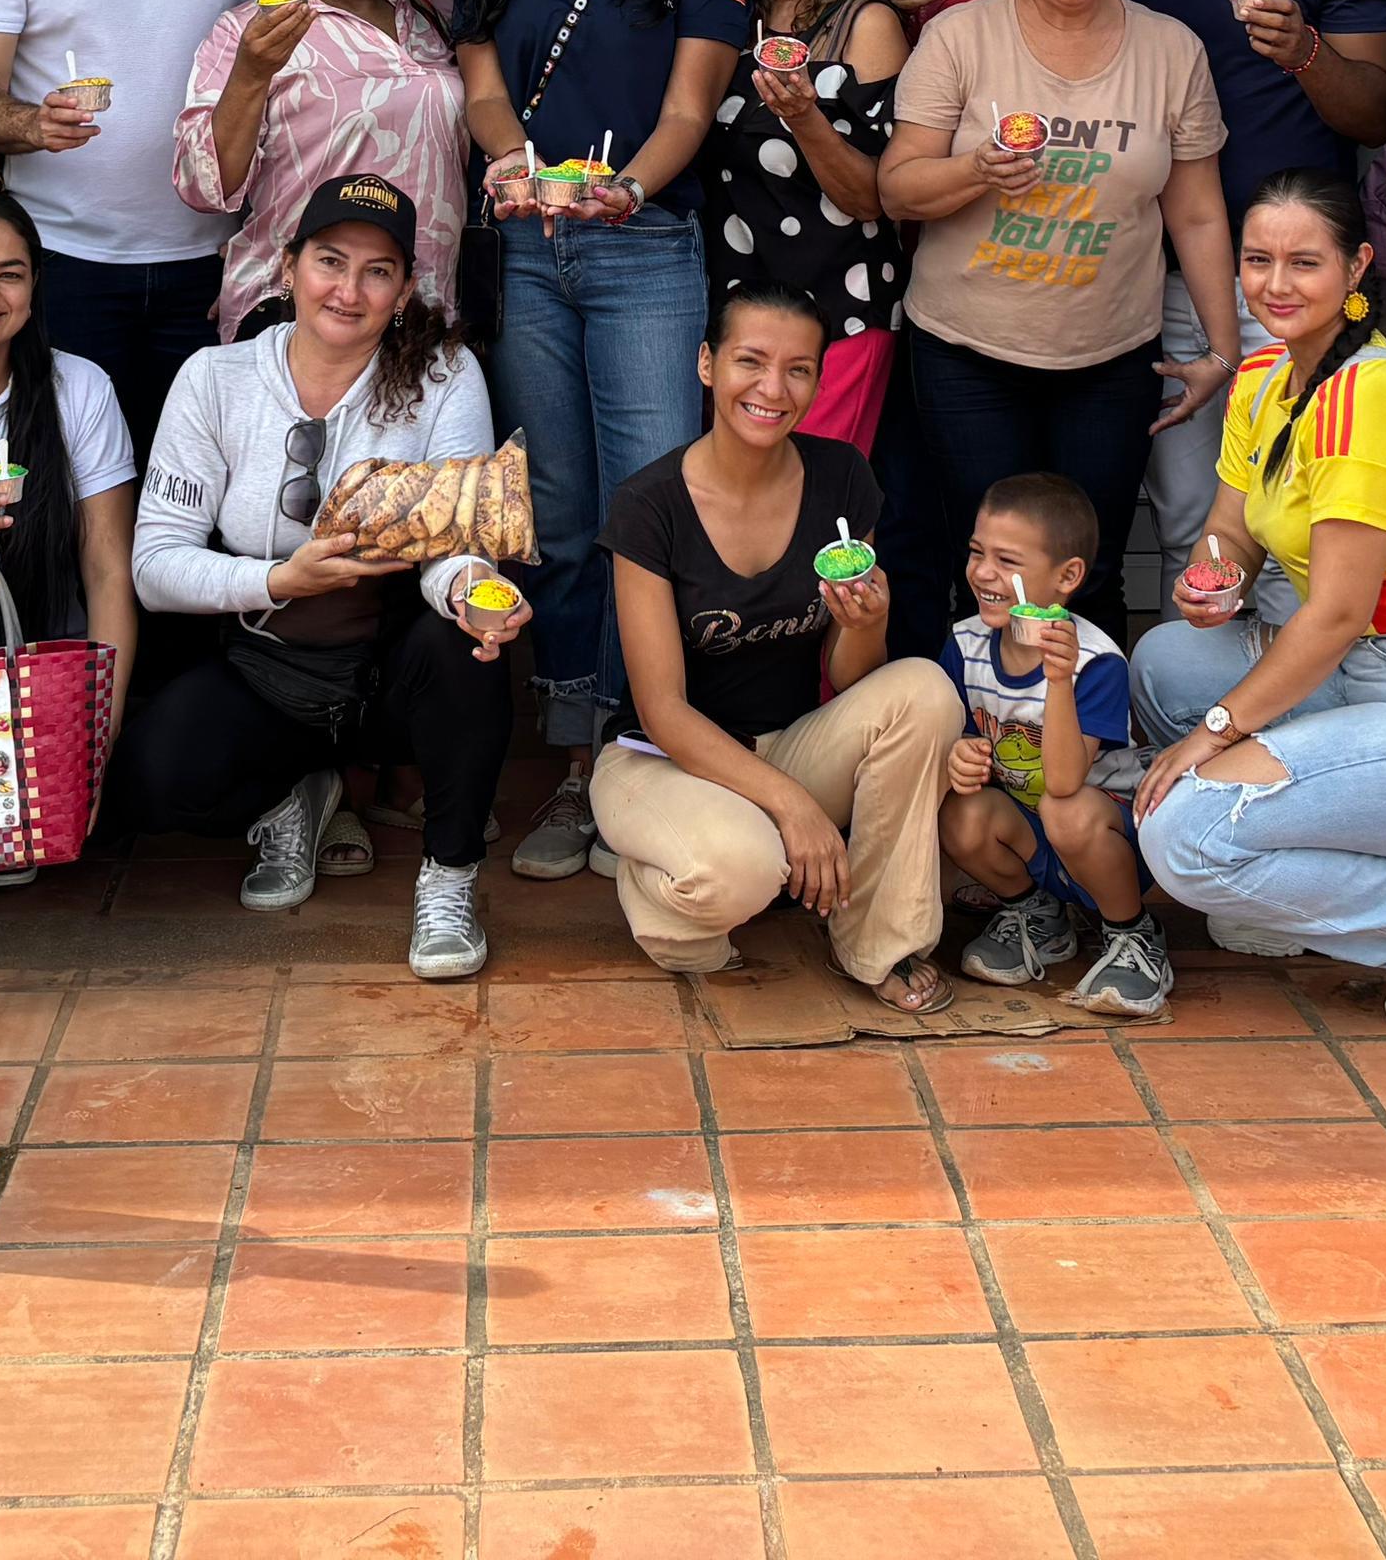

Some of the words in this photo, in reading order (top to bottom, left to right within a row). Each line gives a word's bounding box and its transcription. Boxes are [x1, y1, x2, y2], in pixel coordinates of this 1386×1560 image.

[1036, 113, 1137, 153] ON'T
[1037, 149, 1112, 185] TOP
[990, 209, 1117, 256] YOU'RE
[968, 239, 1105, 288] PROUD
[162, 474, 203, 508] AGAIN
